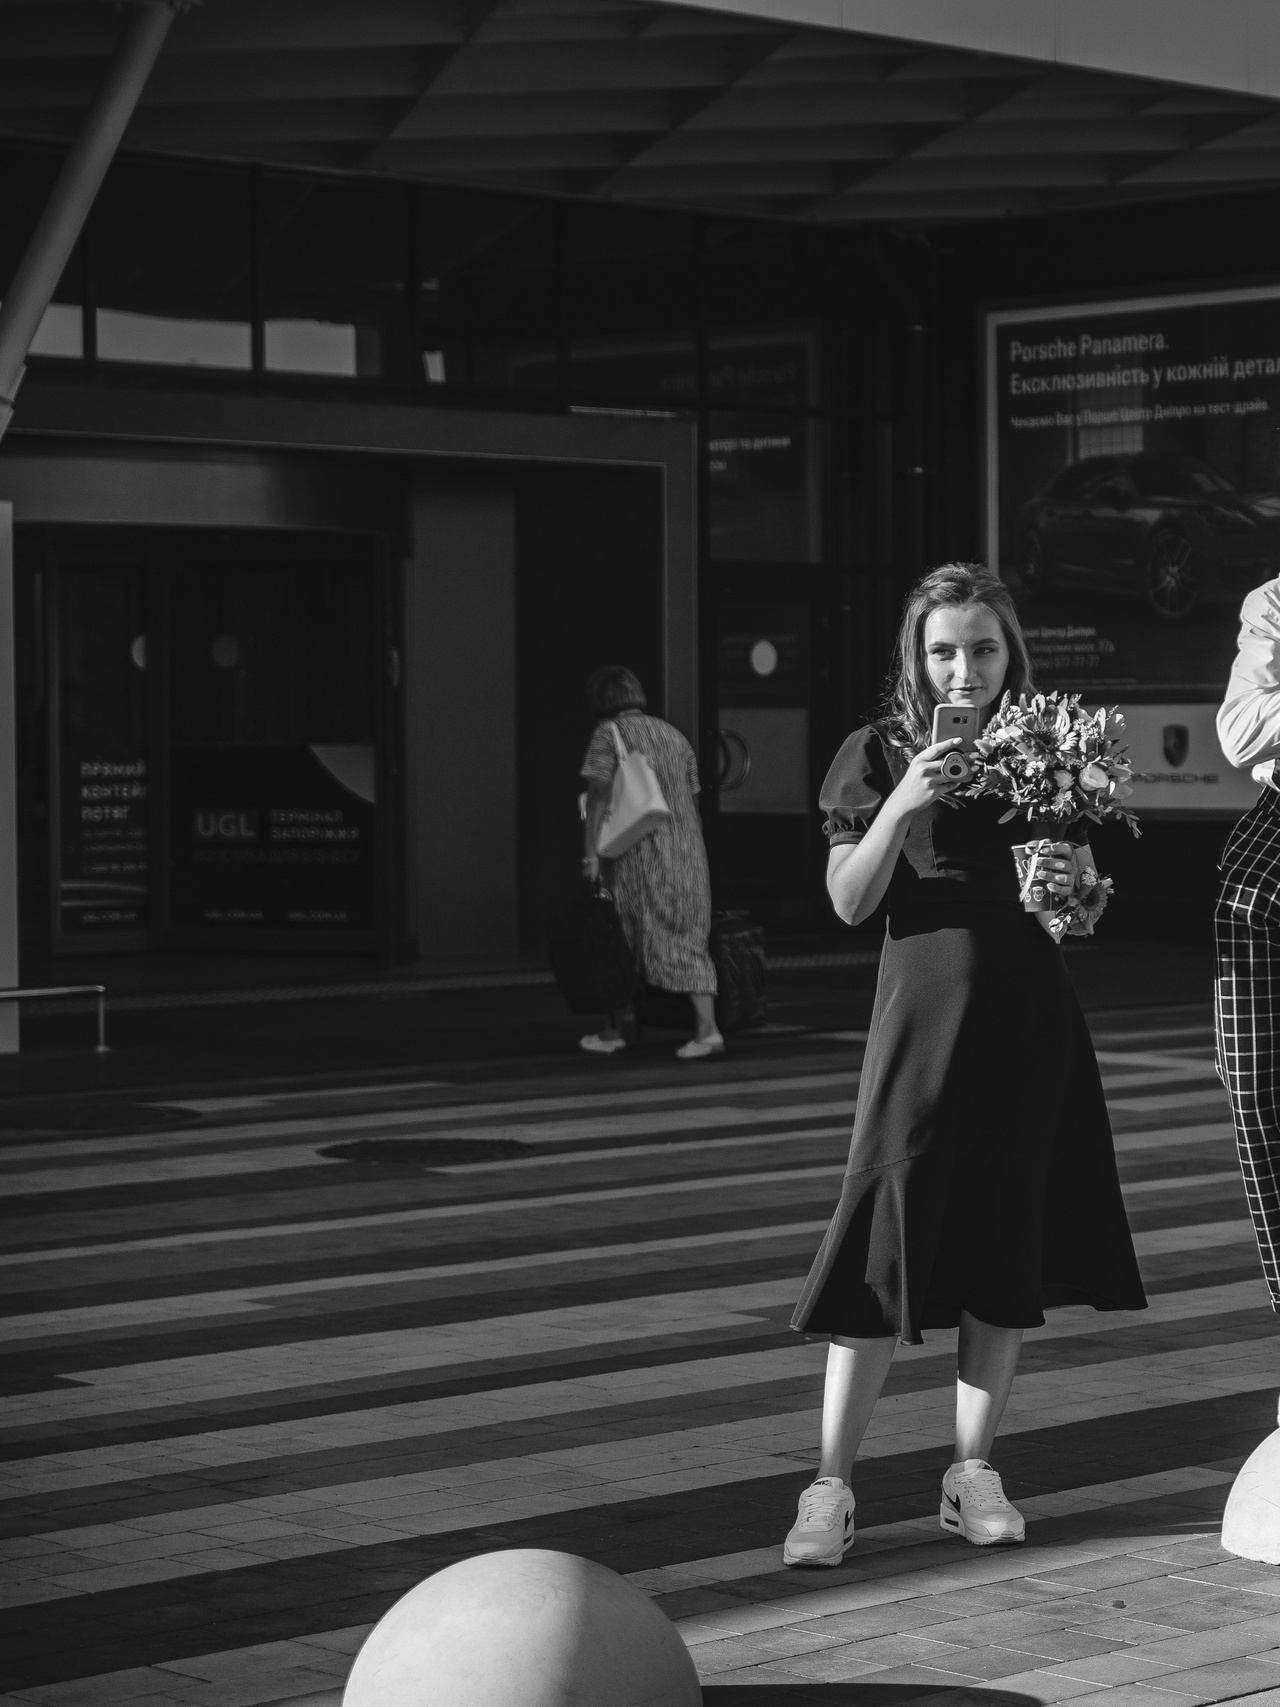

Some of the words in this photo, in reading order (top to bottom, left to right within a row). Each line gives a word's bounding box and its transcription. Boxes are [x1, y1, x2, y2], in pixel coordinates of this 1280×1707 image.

[1010, 338, 1076, 362] Porsche
[1080, 334, 1169, 356] Panamera.
[1011, 365, 1150, 395] Ексклюзивність
[1152, 367, 1164, 389] у
[1166, 356, 1229, 382] кожній
[1056, 412, 1074, 425] Вас
[1120, 407, 1153, 424] Центр
[1154, 403, 1191, 420] Дніпро
[1193, 403, 1207, 415] на
[80, 759, 146, 778] ПРЯМИЙ
[1131, 773, 1219, 784] PORSCHE
[81, 805, 131, 822] ПОТЯГ
[271, 809, 343, 824] ТЕРМІНАЛ
[196, 812, 256, 838] UGL
[271, 826, 360, 841] ЗАПОРІЖЖЯ
